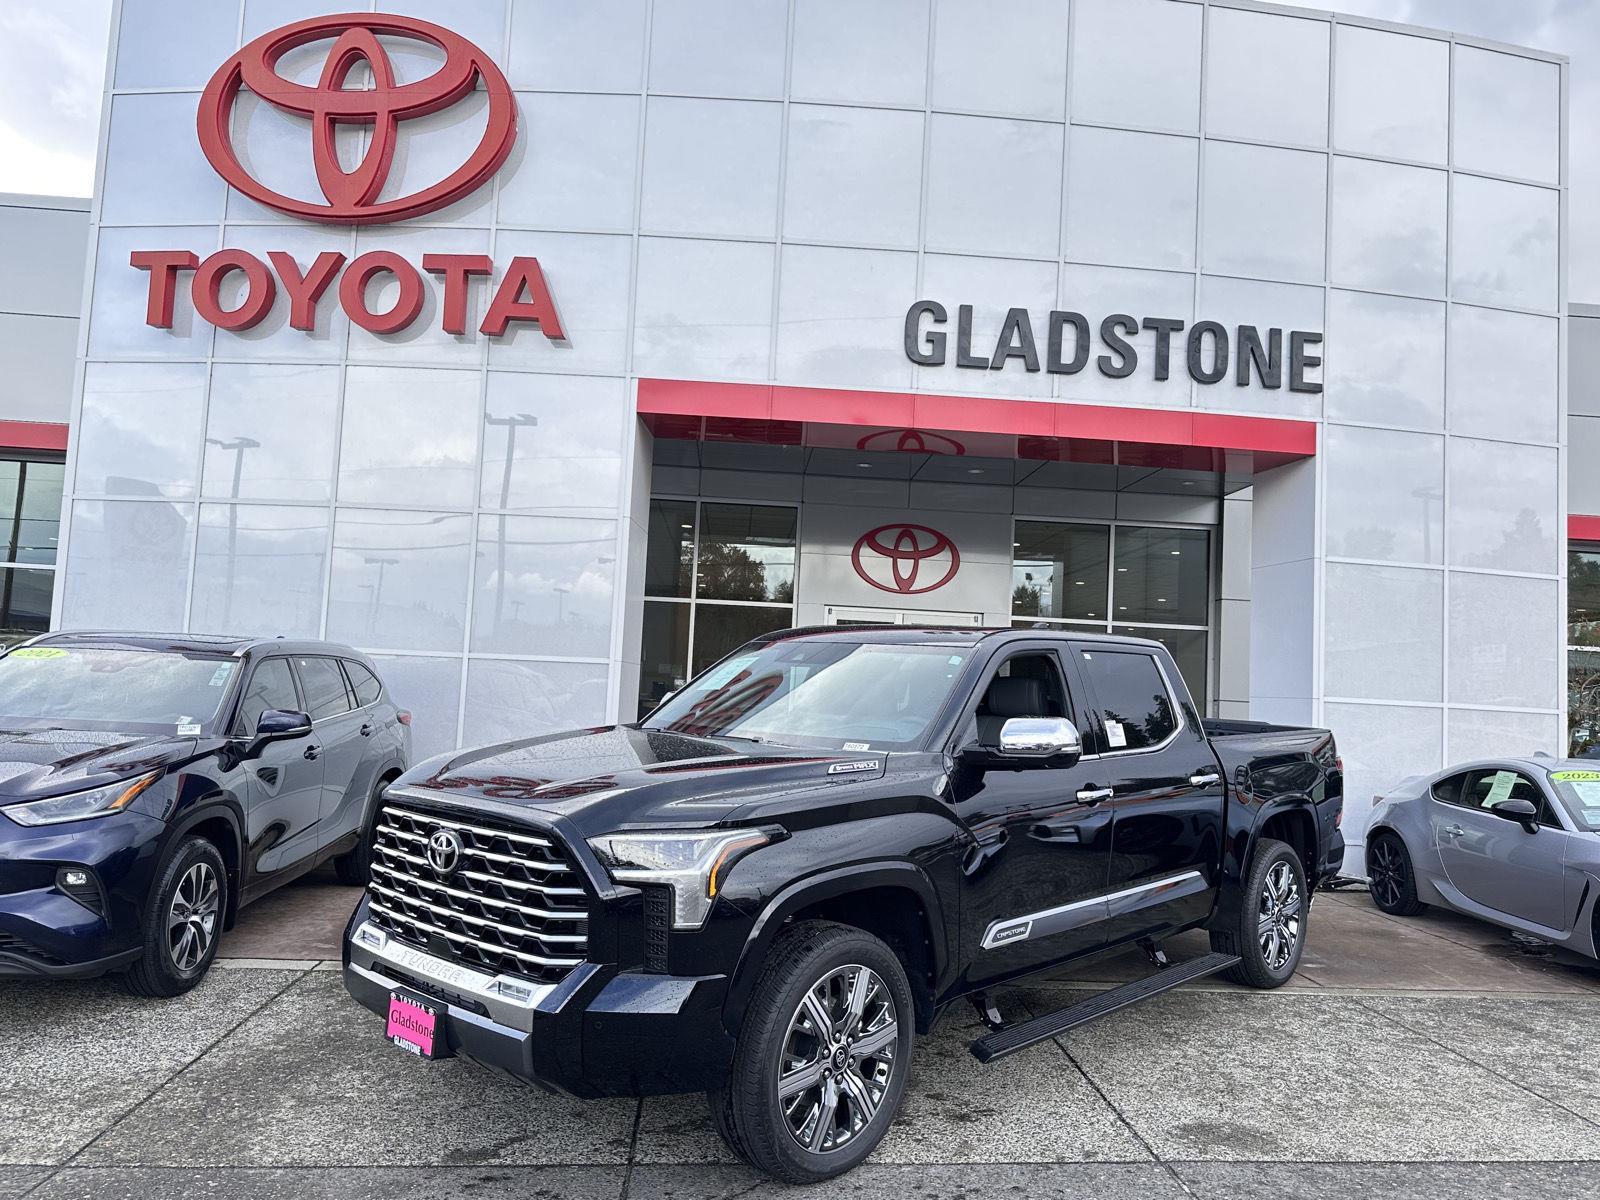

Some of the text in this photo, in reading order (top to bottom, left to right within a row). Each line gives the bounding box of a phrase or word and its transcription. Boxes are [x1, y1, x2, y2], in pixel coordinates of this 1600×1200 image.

[130, 248, 567, 340] TOYOTA
[904, 300, 1324, 394] GLADSTONE
[1562, 772, 1600, 780] 2023
[399, 995, 425, 1012] TOYOTA
[390, 1009, 434, 1040] Gladstone
